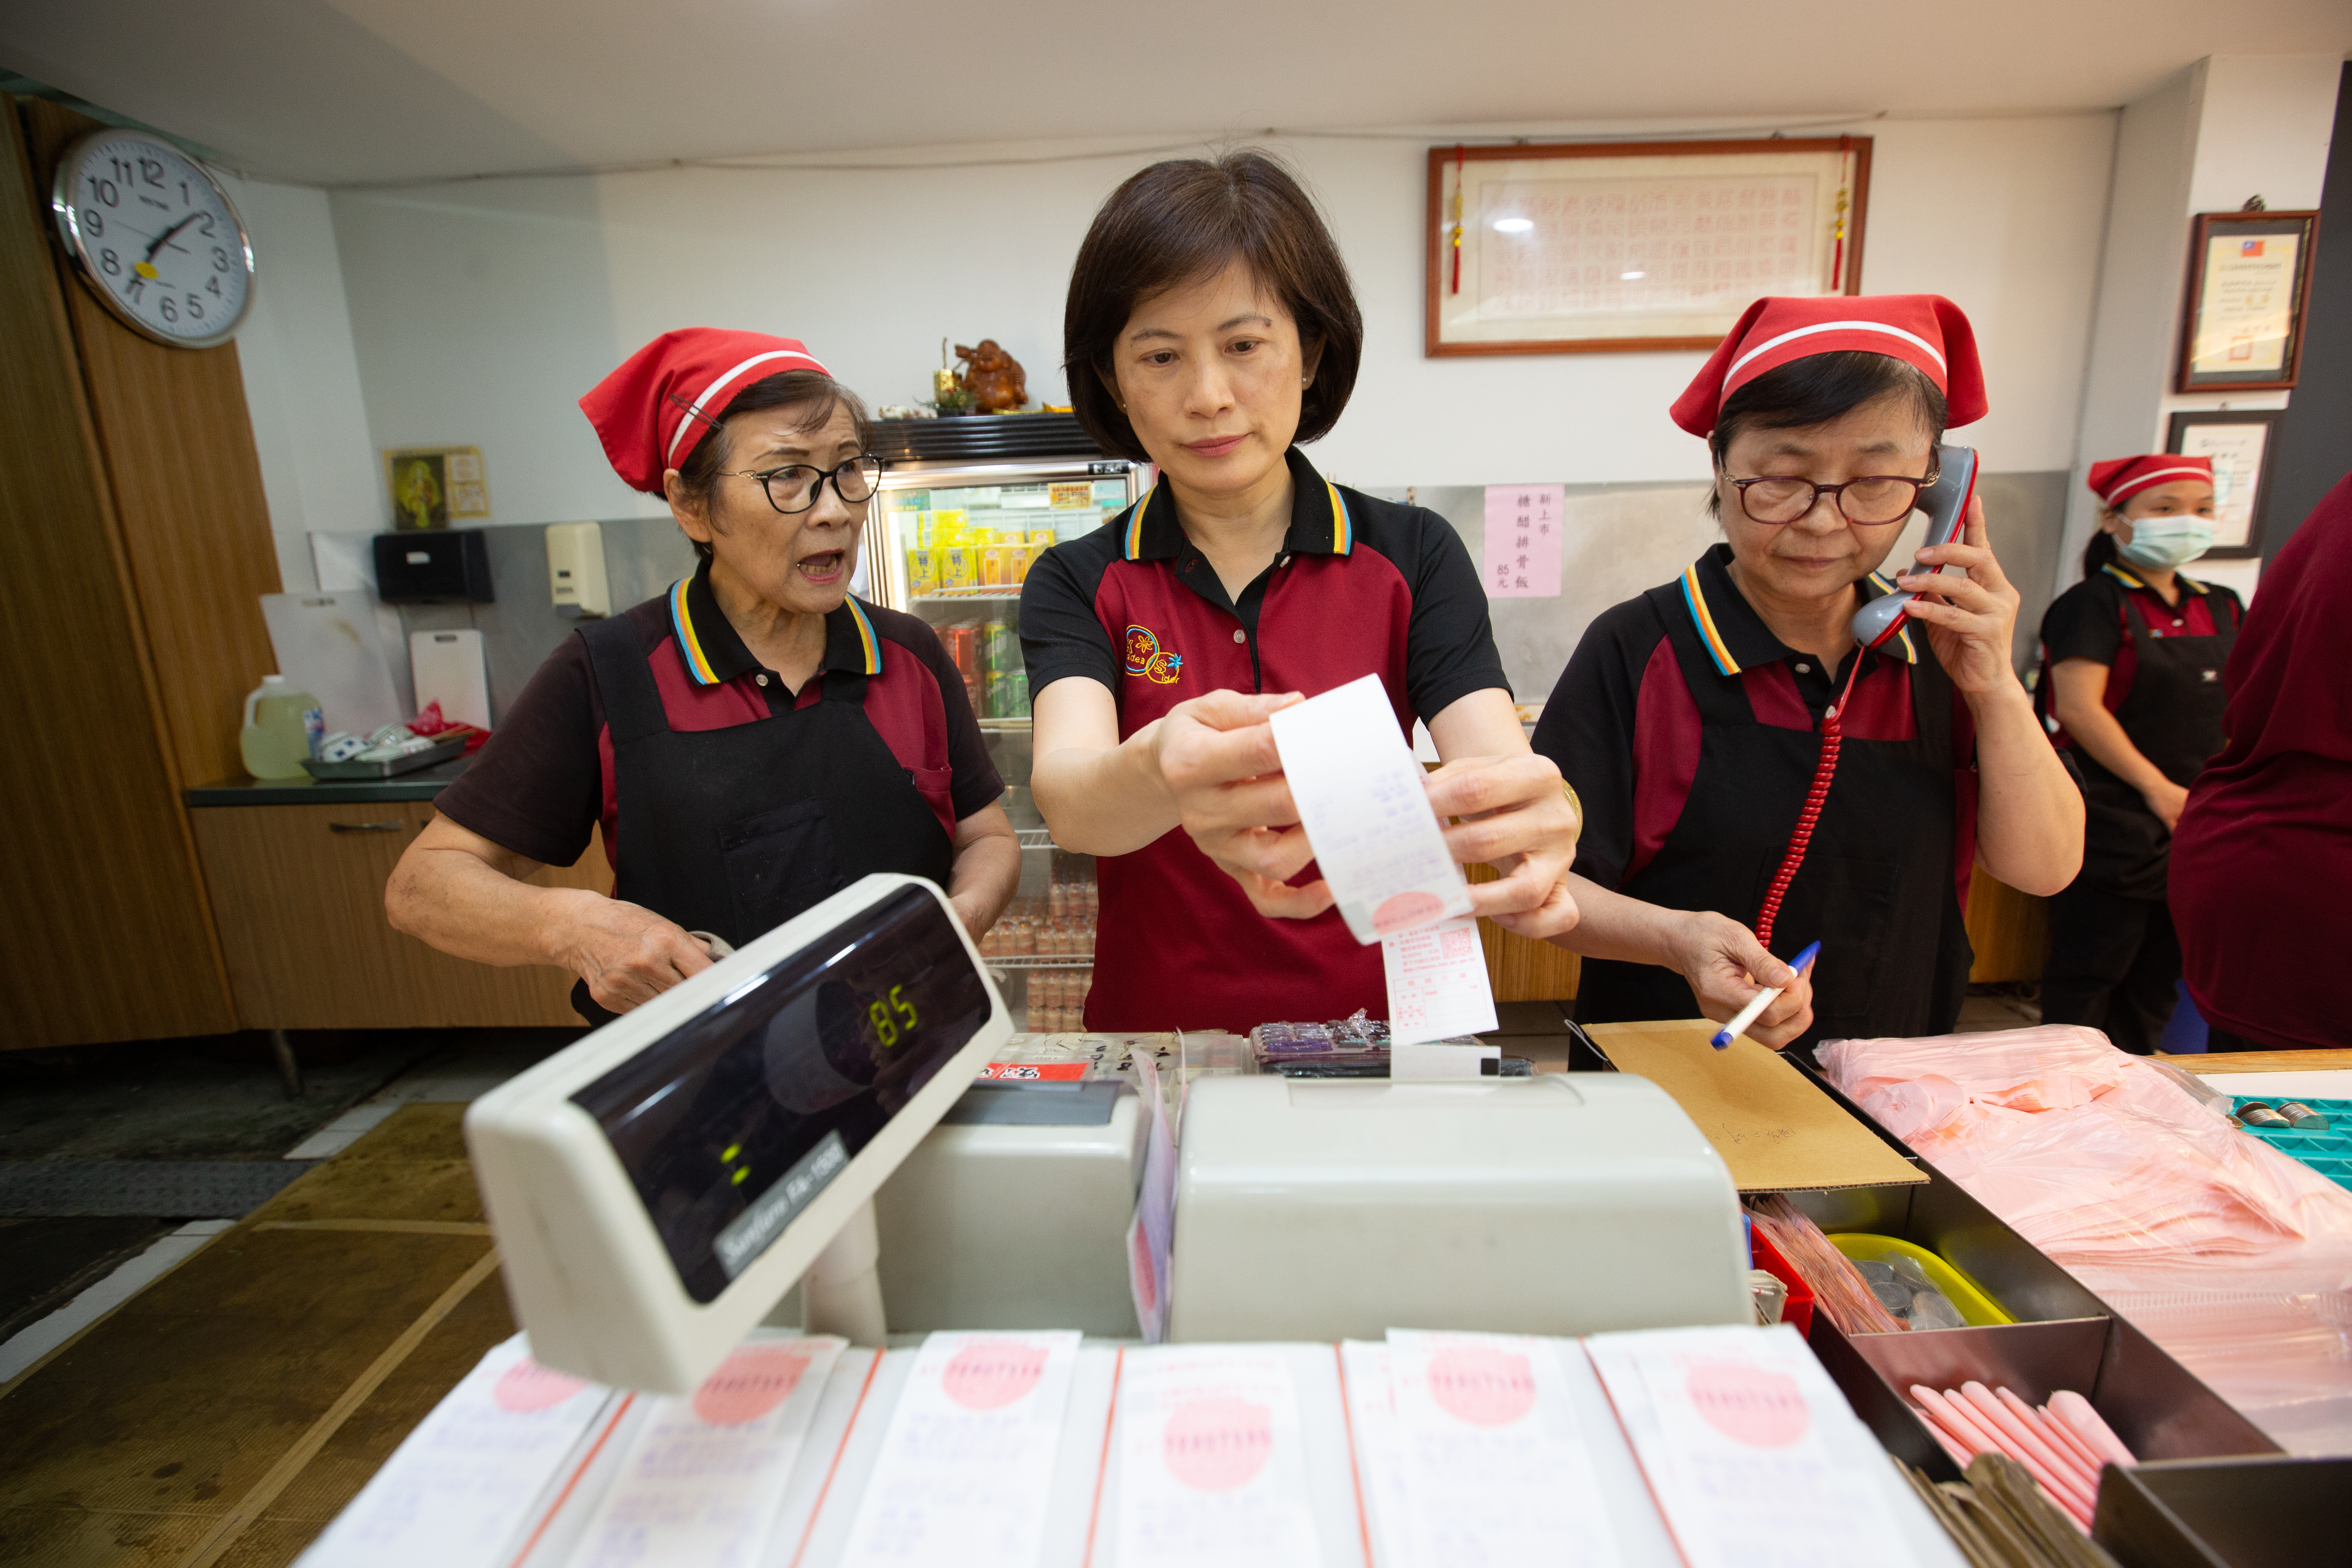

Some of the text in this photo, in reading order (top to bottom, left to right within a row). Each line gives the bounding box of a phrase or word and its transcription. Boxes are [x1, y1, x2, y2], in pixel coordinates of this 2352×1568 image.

[111, 157, 134, 187] 11
[138, 157, 165, 189] 12
[87, 176, 119, 207] 10
[179, 181, 190, 205] 1
[85, 209, 104, 237] 9
[200, 211, 216, 238] 2
[101, 248, 121, 276] 8
[212, 247, 229, 273] 3
[206, 275, 222, 298] 4
[160, 296, 178, 323] 6
[187, 292, 204, 319] 5
[1539, 493, 1551, 537] 新上市
[869, 984, 917, 1048] 85
